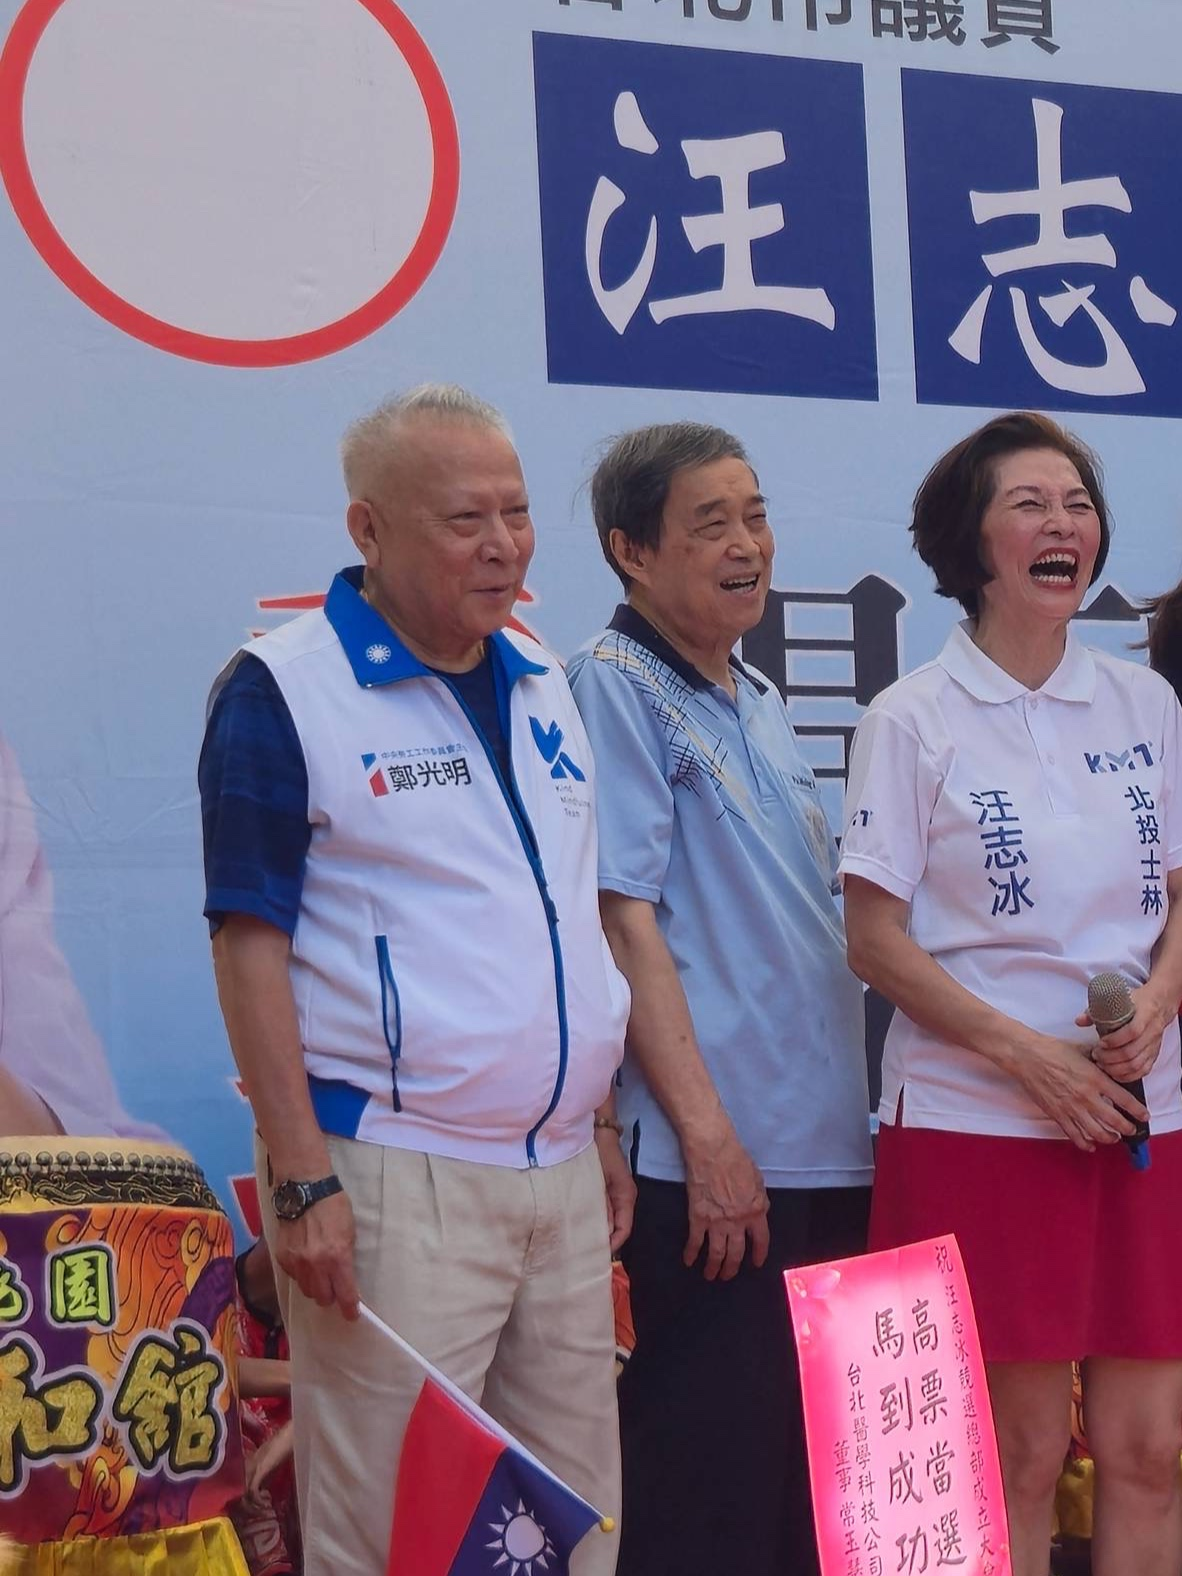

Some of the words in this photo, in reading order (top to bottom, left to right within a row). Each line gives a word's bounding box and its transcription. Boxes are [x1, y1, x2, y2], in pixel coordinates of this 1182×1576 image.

[387, 757, 473, 793] 鄭光明
[1083, 741, 1154, 774] KMT
[969, 789, 1036, 917] 汪志冰
[1124, 785, 1163, 916] 北投士林
[872, 1307, 930, 1576] 馬到成功
[911, 1298, 968, 1569] 高票當選
